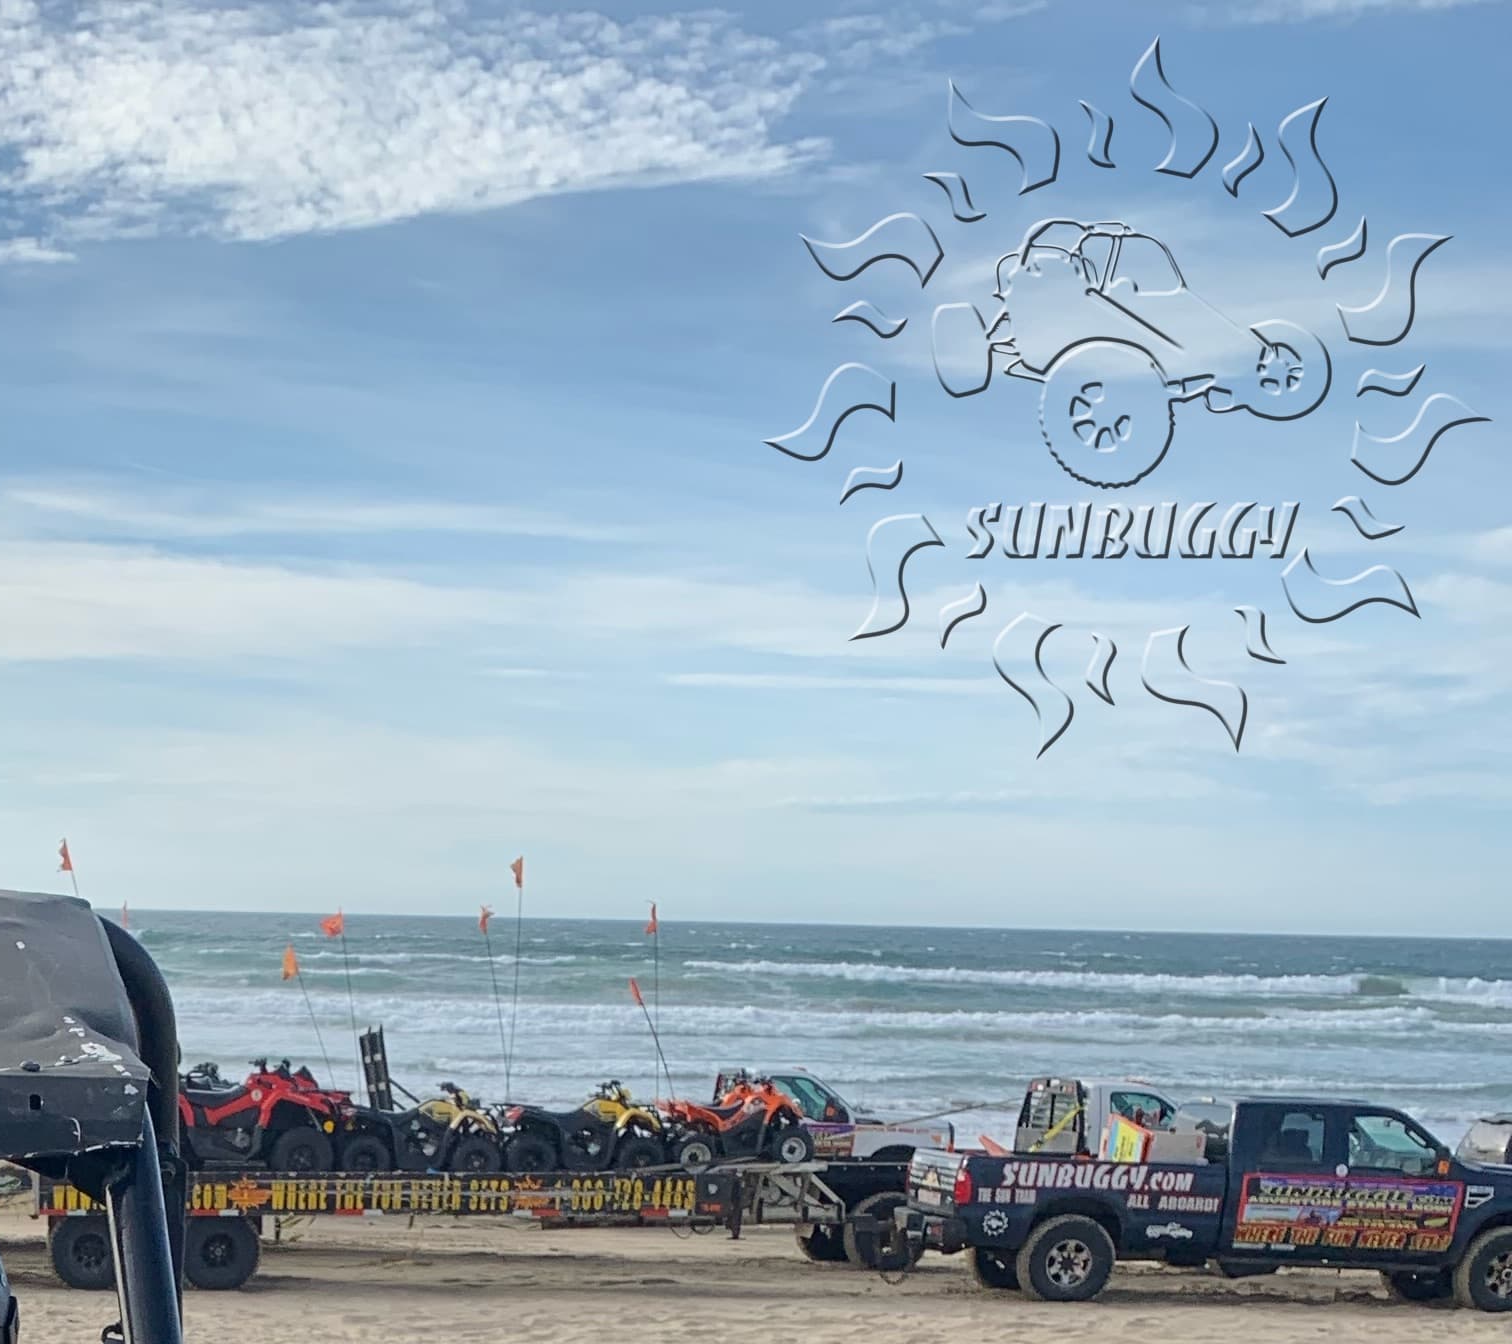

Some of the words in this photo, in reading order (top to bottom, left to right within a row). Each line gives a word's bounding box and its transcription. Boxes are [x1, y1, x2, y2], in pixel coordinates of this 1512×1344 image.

[1001, 1162, 1194, 1191] SUNBUGGY.COM
[271, 1179, 327, 1210] WHERE
[336, 1179, 364, 1210] THE
[372, 1179, 402, 1210] FUN
[411, 1179, 462, 1210] NEVER
[469, 1179, 510, 1211] SETS
[1127, 1194, 1150, 1210] ALL
[1158, 1195, 1219, 1213] ABOARD!
